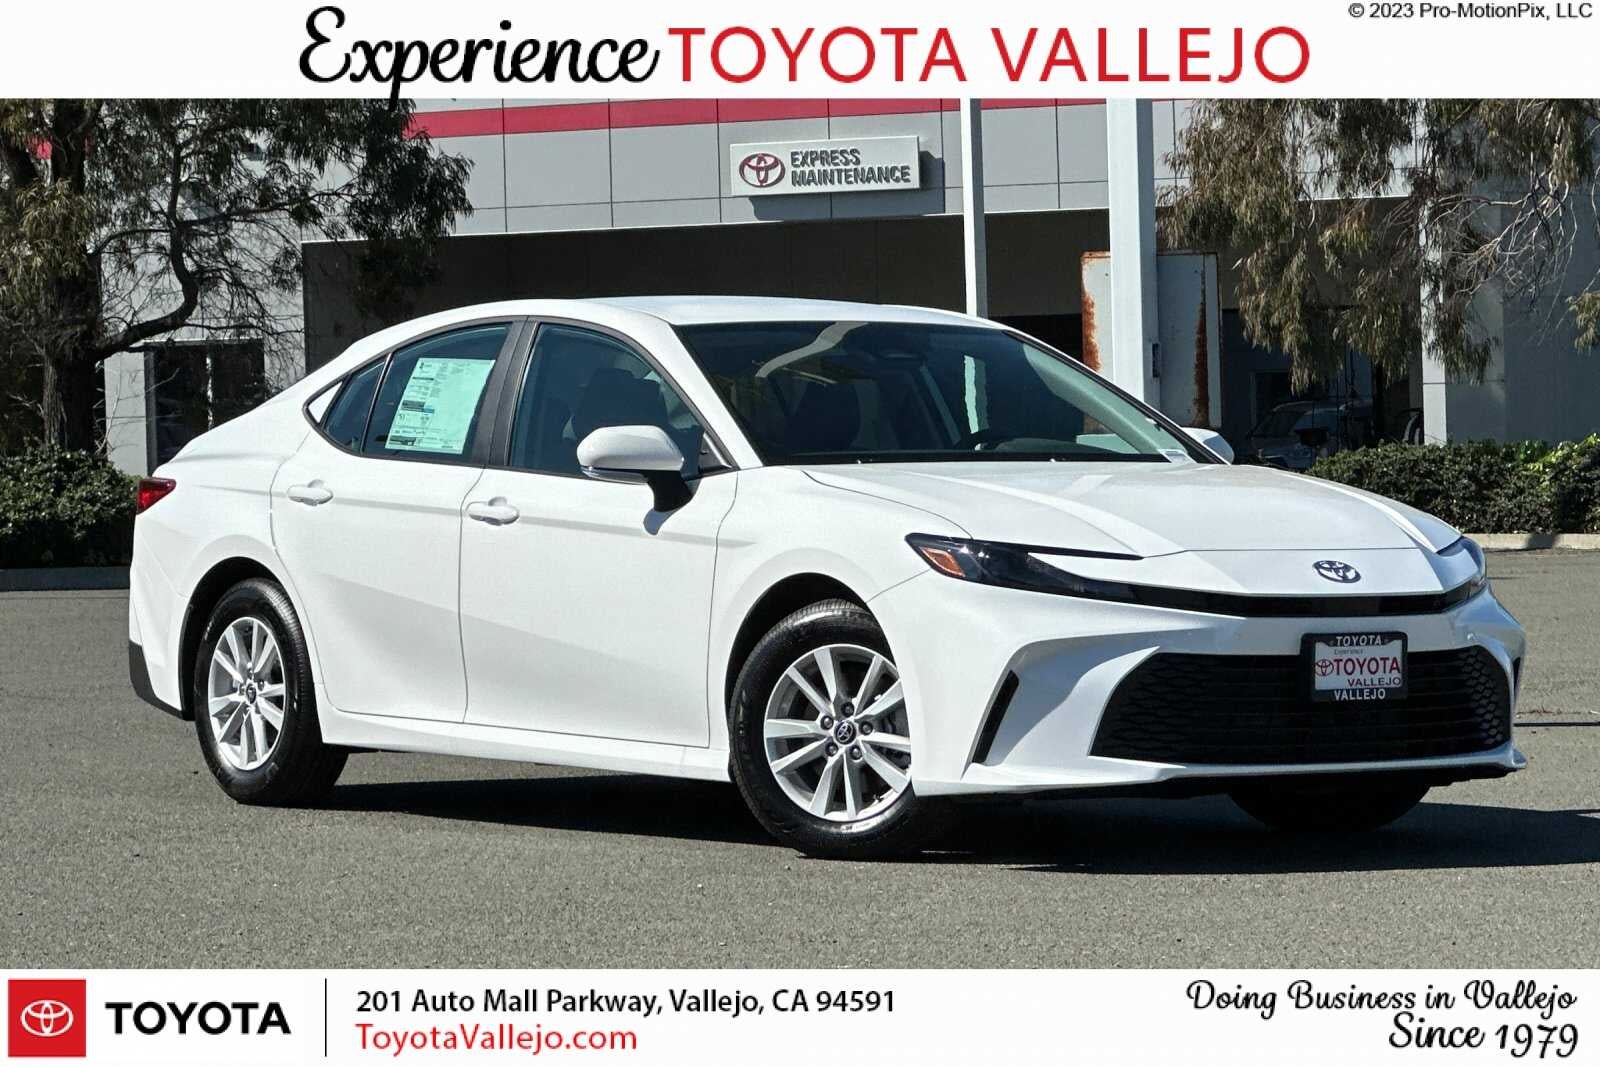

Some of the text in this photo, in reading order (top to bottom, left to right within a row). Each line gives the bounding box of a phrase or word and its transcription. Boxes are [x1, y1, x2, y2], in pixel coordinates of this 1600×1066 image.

[790, 148, 861, 168] EXPRESS
[791, 165, 911, 187] MAINTENANCE
[1336, 635, 1381, 646] TOYOTA
[1334, 657, 1401, 675] TOYOTA
[1347, 677, 1401, 687] VALLEJO
[1334, 688, 1386, 700] VALLEJO
